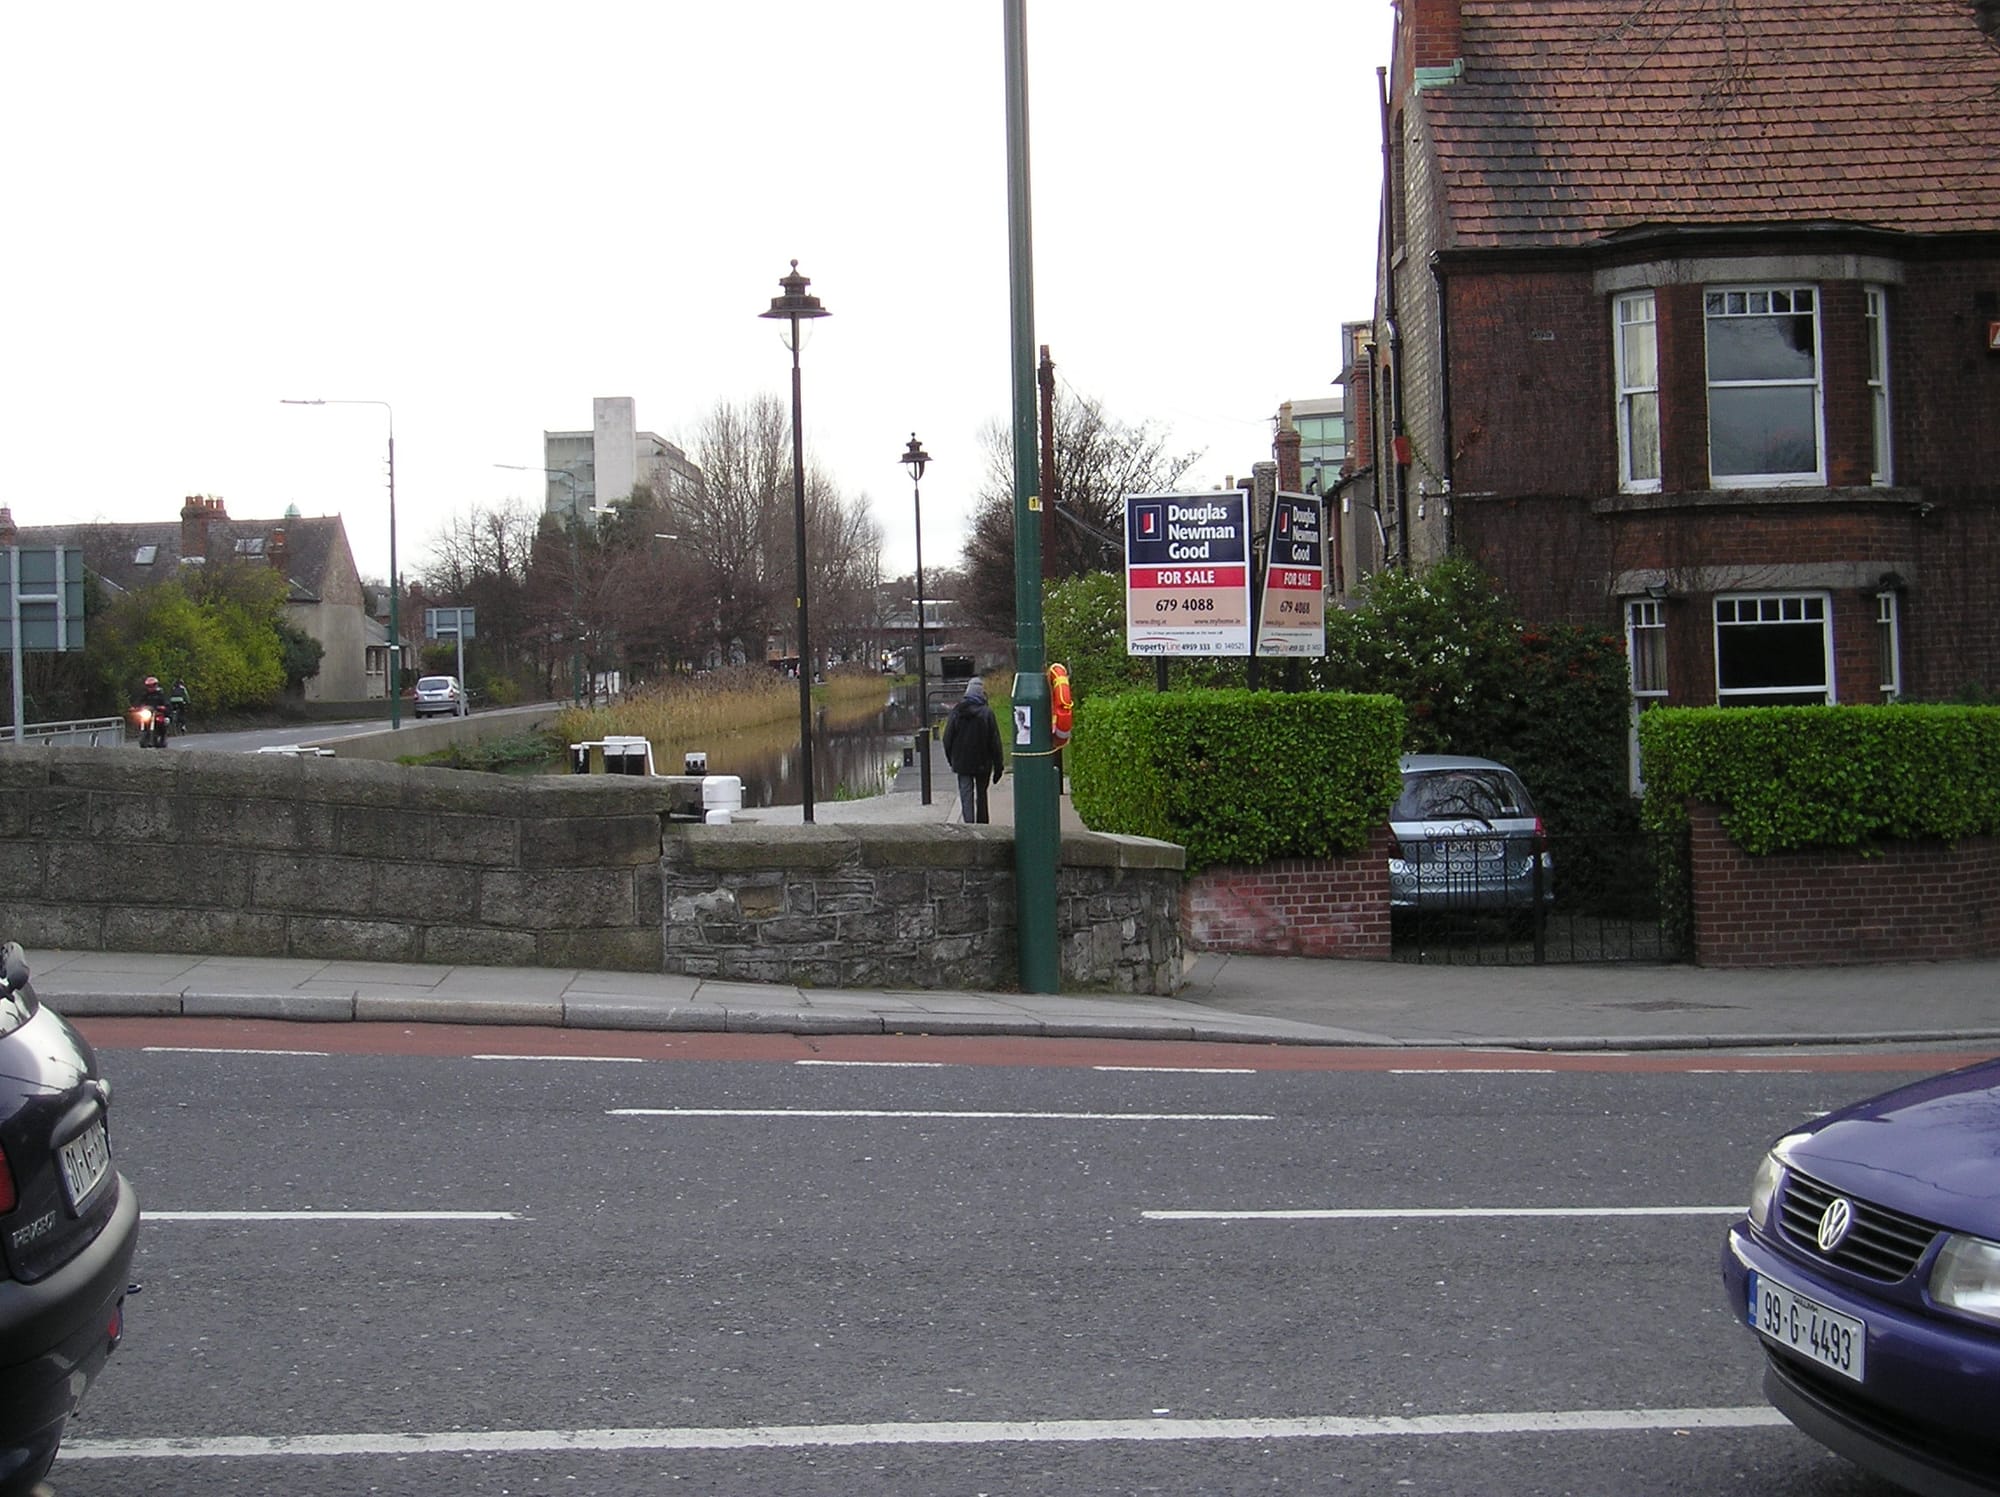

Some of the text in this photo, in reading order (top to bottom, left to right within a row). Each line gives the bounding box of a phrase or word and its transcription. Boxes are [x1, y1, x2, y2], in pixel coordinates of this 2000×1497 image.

[1168, 503, 1228, 525] Douglas
[1293, 506, 1316, 528] Douglas
[1168, 524, 1235, 540] Newman
[1292, 525, 1319, 543] Newman
[1168, 541, 1210, 559] Good
[1292, 544, 1310, 561] Good
[1157, 570, 1215, 584] FOR SALE
[1284, 573, 1311, 586] FOR SALE
[1156, 598, 1214, 612] 679 4088
[1280, 600, 1293, 613] 679
[12, 1210, 56, 1248] PEUGEOT
